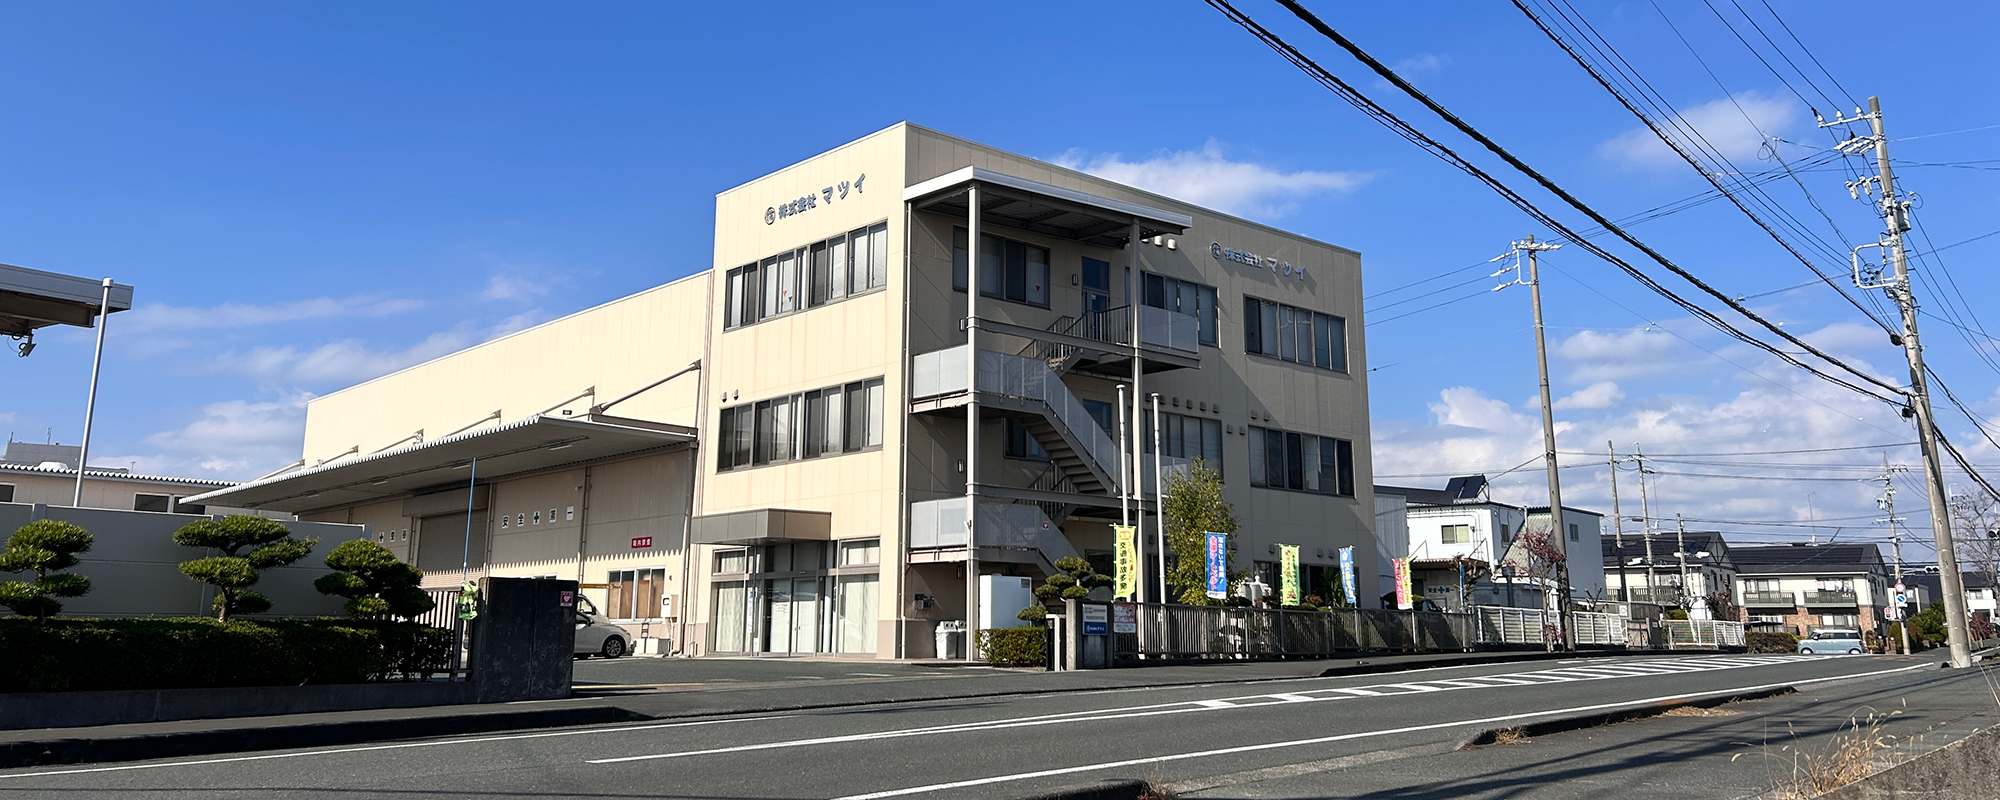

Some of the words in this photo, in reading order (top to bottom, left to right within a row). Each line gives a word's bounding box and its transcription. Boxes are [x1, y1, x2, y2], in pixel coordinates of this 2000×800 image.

[778, 193, 817, 220] 株式会社
[821, 173, 866, 205] マツイ
[1223, 246, 1264, 269] 株式会社
[1266, 256, 1306, 281] マツイ
